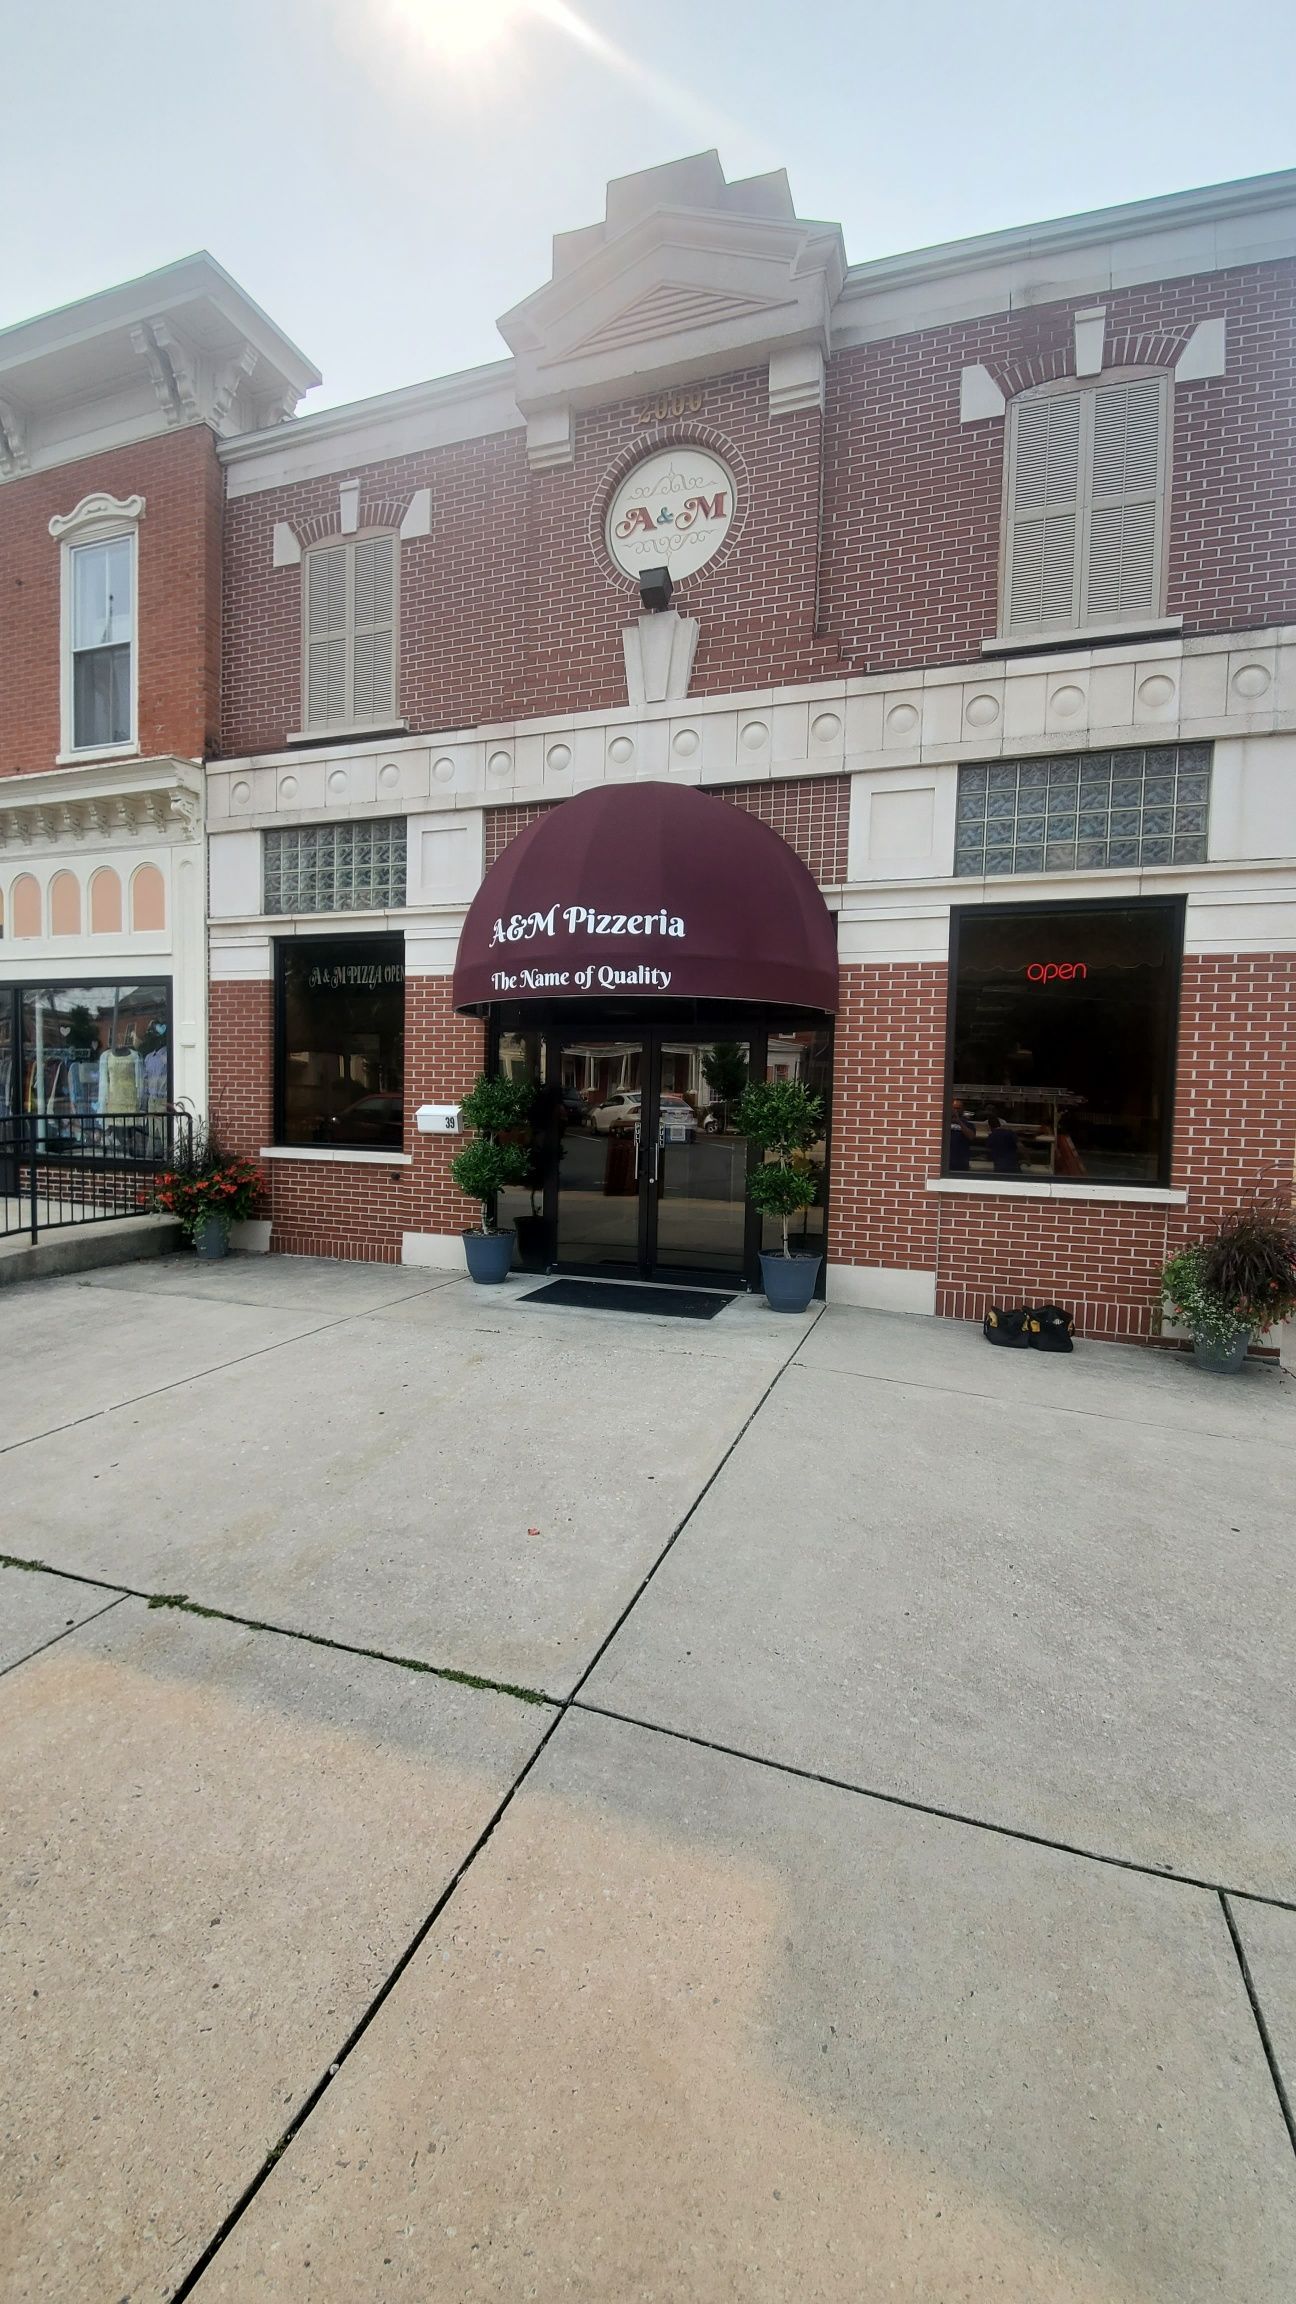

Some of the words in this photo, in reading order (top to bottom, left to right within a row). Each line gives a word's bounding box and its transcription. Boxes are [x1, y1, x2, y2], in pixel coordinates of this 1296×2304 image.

[639, 387, 704, 423] 2000
[489, 903, 560, 948] A&M
[562, 906, 686, 938] Pizzeria
[346, 964, 382, 990] PIZZA
[491, 971, 517, 991] The
[520, 969, 569, 989] Name
[575, 965, 596, 990] of
[598, 965, 672, 990] Quality
[1027, 962, 1087, 985] open
[445, 1116, 455, 1129] 39
